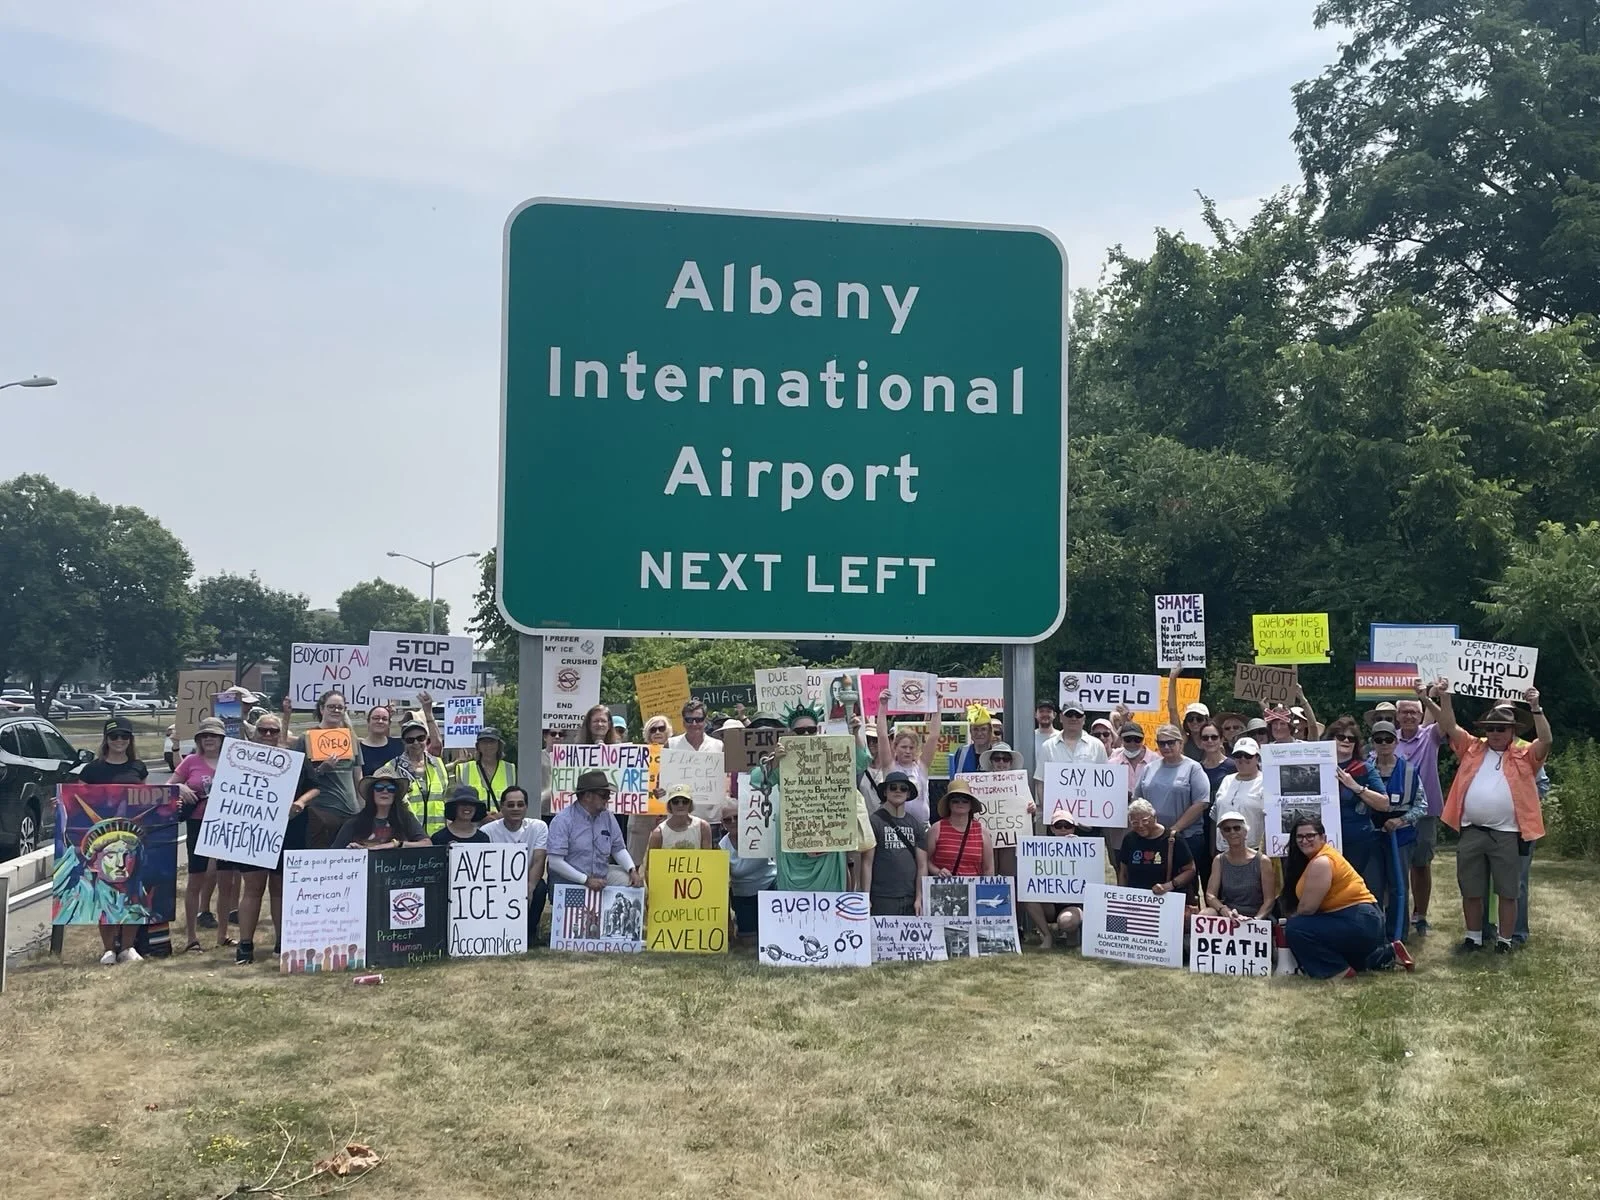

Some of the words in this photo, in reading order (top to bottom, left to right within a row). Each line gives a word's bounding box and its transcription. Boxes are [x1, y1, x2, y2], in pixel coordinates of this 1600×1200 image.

[665, 260, 920, 334] Albany
[549, 346, 1024, 415] International
[664, 446, 919, 512] Airport
[641, 551, 782, 591] NEXT
[807, 555, 936, 595] LEFT
[1158, 595, 1200, 610] SHAME
[1178, 609, 1203, 623] ICE
[1259, 616, 1285, 628] avelo
[1301, 627, 1310, 637] to
[1315, 627, 1324, 638] El
[396, 640, 449, 655] STOP
[1259, 640, 1292, 656] Salvador
[1296, 640, 1325, 654] GULAG
[1467, 642, 1517, 653] DETENTION
[293, 646, 344, 665] BOYCOTT
[348, 649, 369, 667] AV
[323, 665, 351, 680] NO
[389, 657, 454, 674] AVELO
[1458, 657, 1528, 678] UPHOLD
[373, 676, 467, 691] ABDUCTIONS
[768, 672, 788, 683] DUE
[807, 676, 821, 686] ELO
[1086, 675, 1101, 684] NO
[1113, 675, 1135, 686] GO!
[1240, 665, 1296, 687] BOYCOTT
[1358, 676, 1393, 686] DISARM
[1470, 672, 1503, 688] THE
[296, 684, 323, 703] ICE
[761, 684, 802, 697] PROCESS
[1079, 689, 1149, 704] AVELO
[1242, 683, 1287, 700] AVELO
[448, 699, 482, 708] PEOPLE
[188, 707, 208, 725] IC
[454, 715, 477, 724] NOT
[320, 737, 348, 750] AVELO
[237, 749, 285, 768] avelo
[566, 746, 600, 767] HATE
[619, 746, 650, 768] FEAR
[240, 773, 270, 788] IT'S
[621, 769, 649, 792] ARE
[679, 767, 716, 779] ICE
[1059, 769, 1086, 786] SAY
[1094, 769, 1114, 787] NO
[128, 788, 172, 805] HOPE
[220, 782, 278, 803] CALLED
[1076, 789, 1087, 797] TO
[220, 799, 279, 821] HUMAN
[615, 793, 647, 813] HERE
[979, 800, 1006, 815] DUE
[1054, 799, 1114, 819] AVELO
[746, 788, 762, 850] HAME
[204, 818, 283, 857] TRAFFICKING
[1022, 841, 1096, 857] IMMIGRANTS
[287, 856, 302, 867] Not
[375, 859, 396, 873] How
[399, 859, 416, 873] long
[454, 850, 526, 882] AVELO
[668, 857, 702, 873] HELL
[1034, 860, 1077, 876] BUILT
[290, 872, 298, 883] I
[320, 872, 343, 885] pissed
[980, 876, 1007, 884] PLANE
[297, 888, 341, 901] American
[674, 877, 702, 899] NO
[1027, 879, 1086, 895] AMERICA
[453, 886, 521, 920] ICE's
[771, 893, 830, 913] avelo
[1126, 894, 1165, 904] GESTAPO
[313, 905, 320, 914] I
[654, 907, 720, 923] COMPLICIT
[874, 917, 899, 928] What
[1195, 917, 1240, 936] STOP
[1247, 923, 1268, 935] The
[377, 930, 413, 942] Protect
[450, 923, 521, 954] Accomplice
[652, 928, 724, 951] AVELO
[900, 930, 933, 941] NOW
[1097, 933, 1129, 941] ALLIGATOR
[1131, 938, 1163, 946] ALCATRAZ
[392, 942, 422, 952] Human
[556, 941, 637, 953] DEMOCRACY
[1098, 941, 1148, 952] CONCENTRATION
[1198, 938, 1268, 958] DEATH
[408, 950, 442, 963] Rights!
[898, 951, 934, 960] THEN
